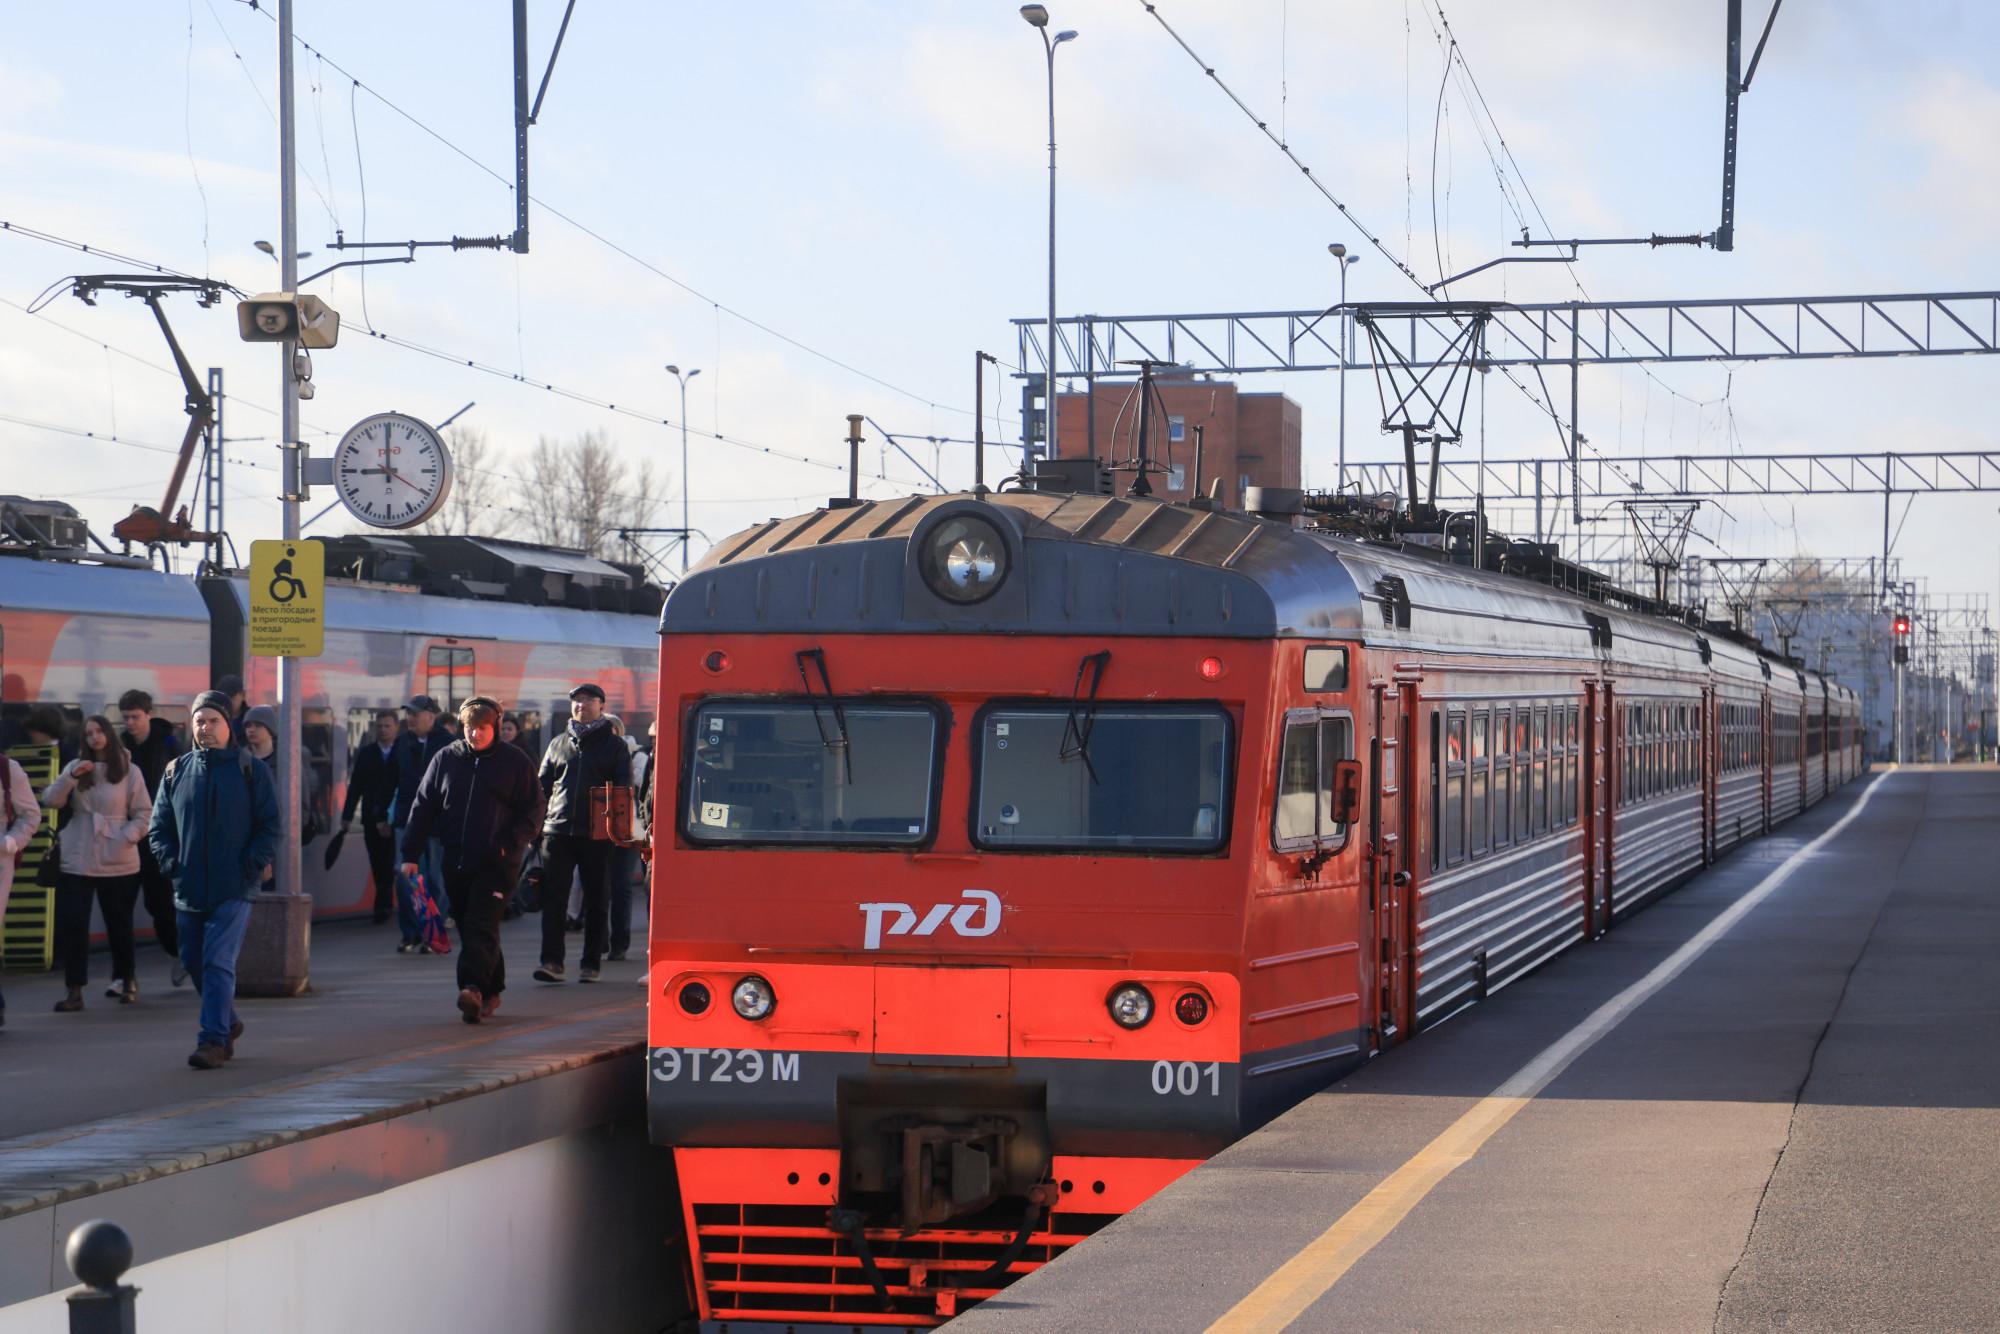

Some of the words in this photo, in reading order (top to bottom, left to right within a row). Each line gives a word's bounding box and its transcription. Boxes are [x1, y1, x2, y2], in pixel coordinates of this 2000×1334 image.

[252, 606, 279, 614] Место
[281, 607, 316, 615] посадки
[1151, 1060, 1220, 1096] 001
